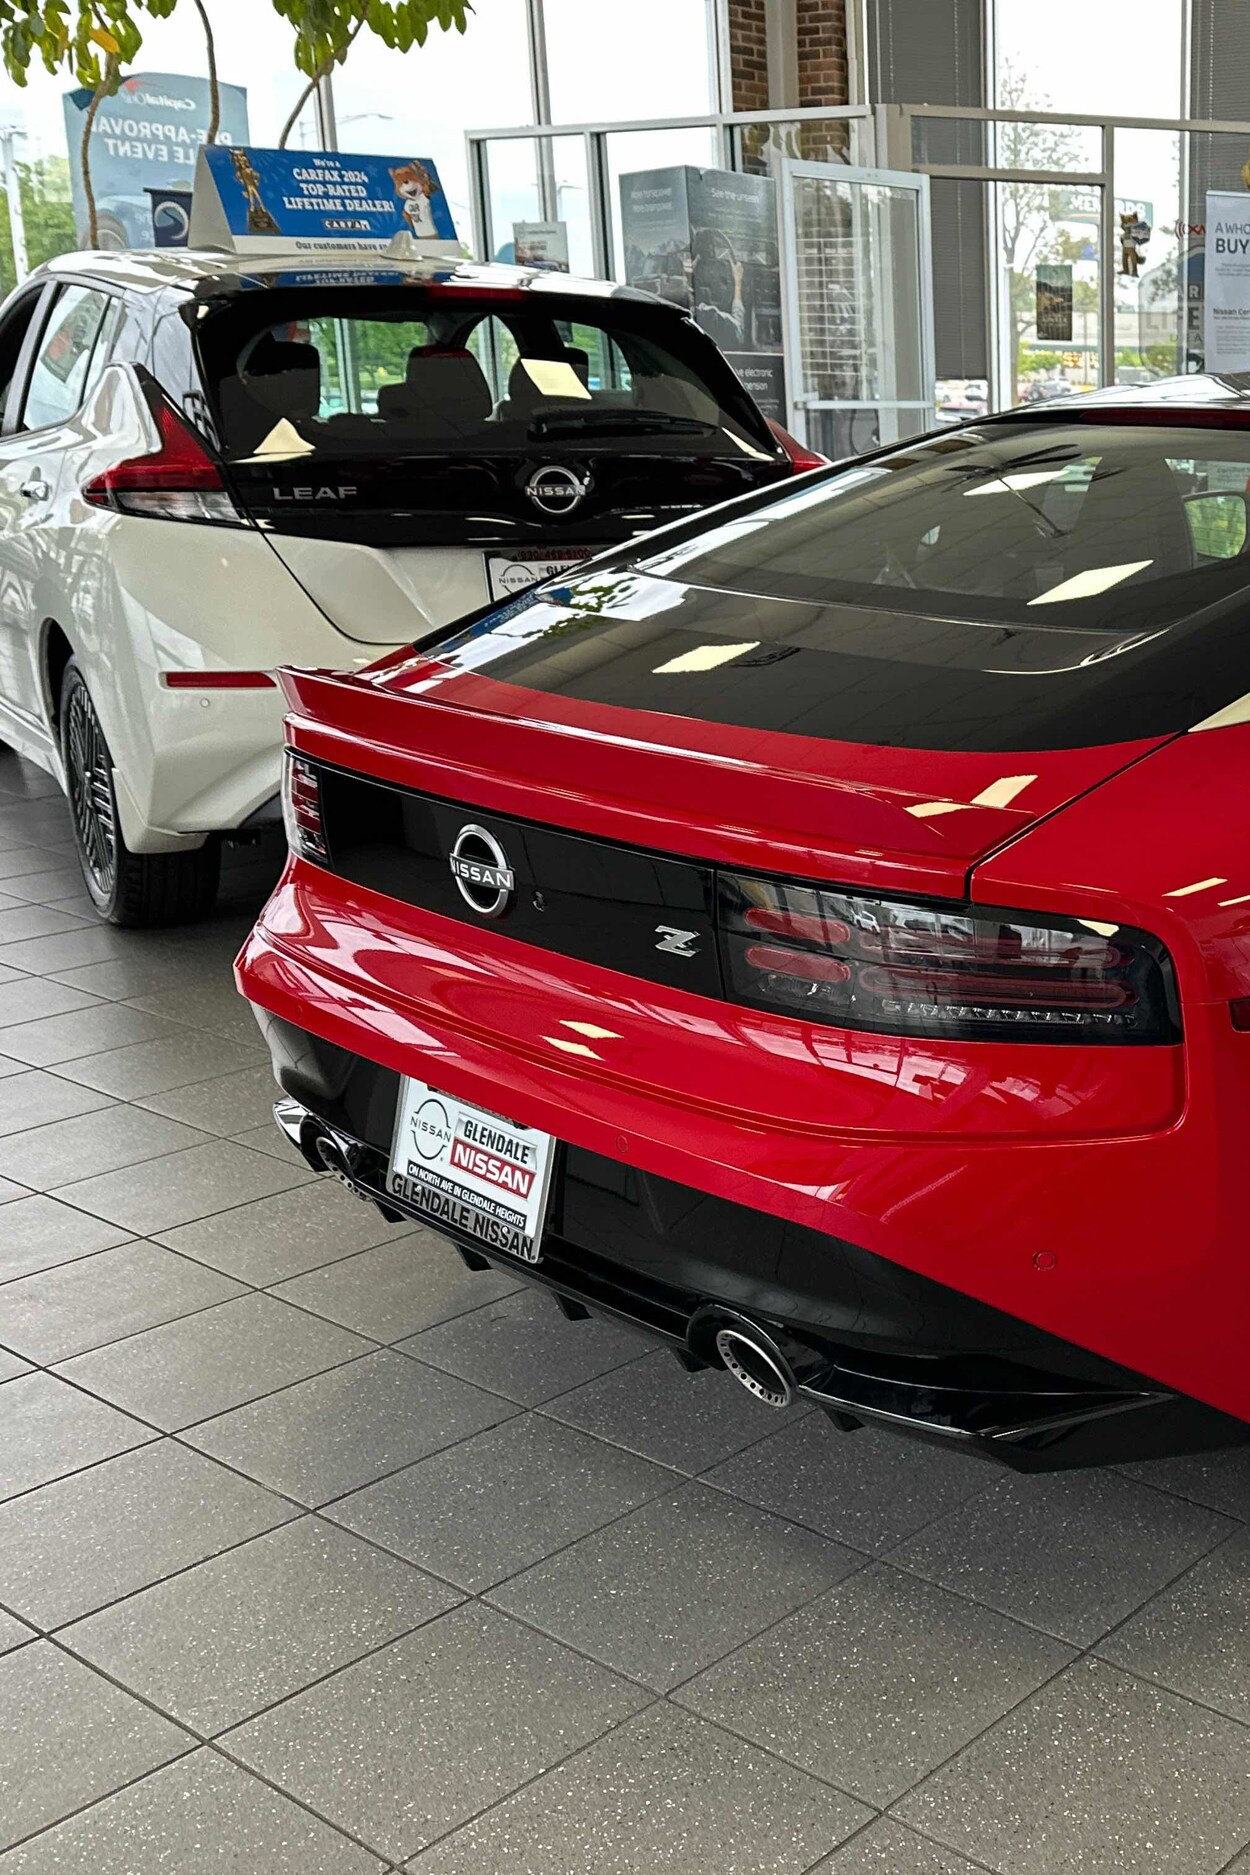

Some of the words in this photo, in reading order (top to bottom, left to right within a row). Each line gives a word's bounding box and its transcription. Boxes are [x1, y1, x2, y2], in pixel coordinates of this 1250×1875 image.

[293, 168, 341, 183] CARFAX
[342, 171, 369, 184] 2024
[299, 183, 367, 198] TOP-RATED
[282, 197, 343, 211] LIFETIME
[345, 199, 395, 212] DEALER!
[1069, 195, 1146, 219] MENRDS
[1215, 222, 1224, 233] A
[1215, 238, 1250, 254] BUY
[272, 486, 357, 501] LEAF
[526, 486, 585, 497] NISSAN
[450, 859, 511, 888] NISSAN
[410, 1117, 451, 1143] NISSAN
[463, 1119, 531, 1165] GLENDALE
[454, 1143, 530, 1195] NISSAN
[408, 1164, 419, 1175] ON
[419, 1168, 440, 1186] NORTH
[440, 1178, 453, 1193] AVE
[454, 1185, 461, 1198] IN
[461, 1189, 495, 1214] GLENDALE
[496, 1204, 525, 1228] HEIGHTS
[391, 1174, 470, 1228] GLENDALE
[472, 1213, 534, 1260] NISSAN
